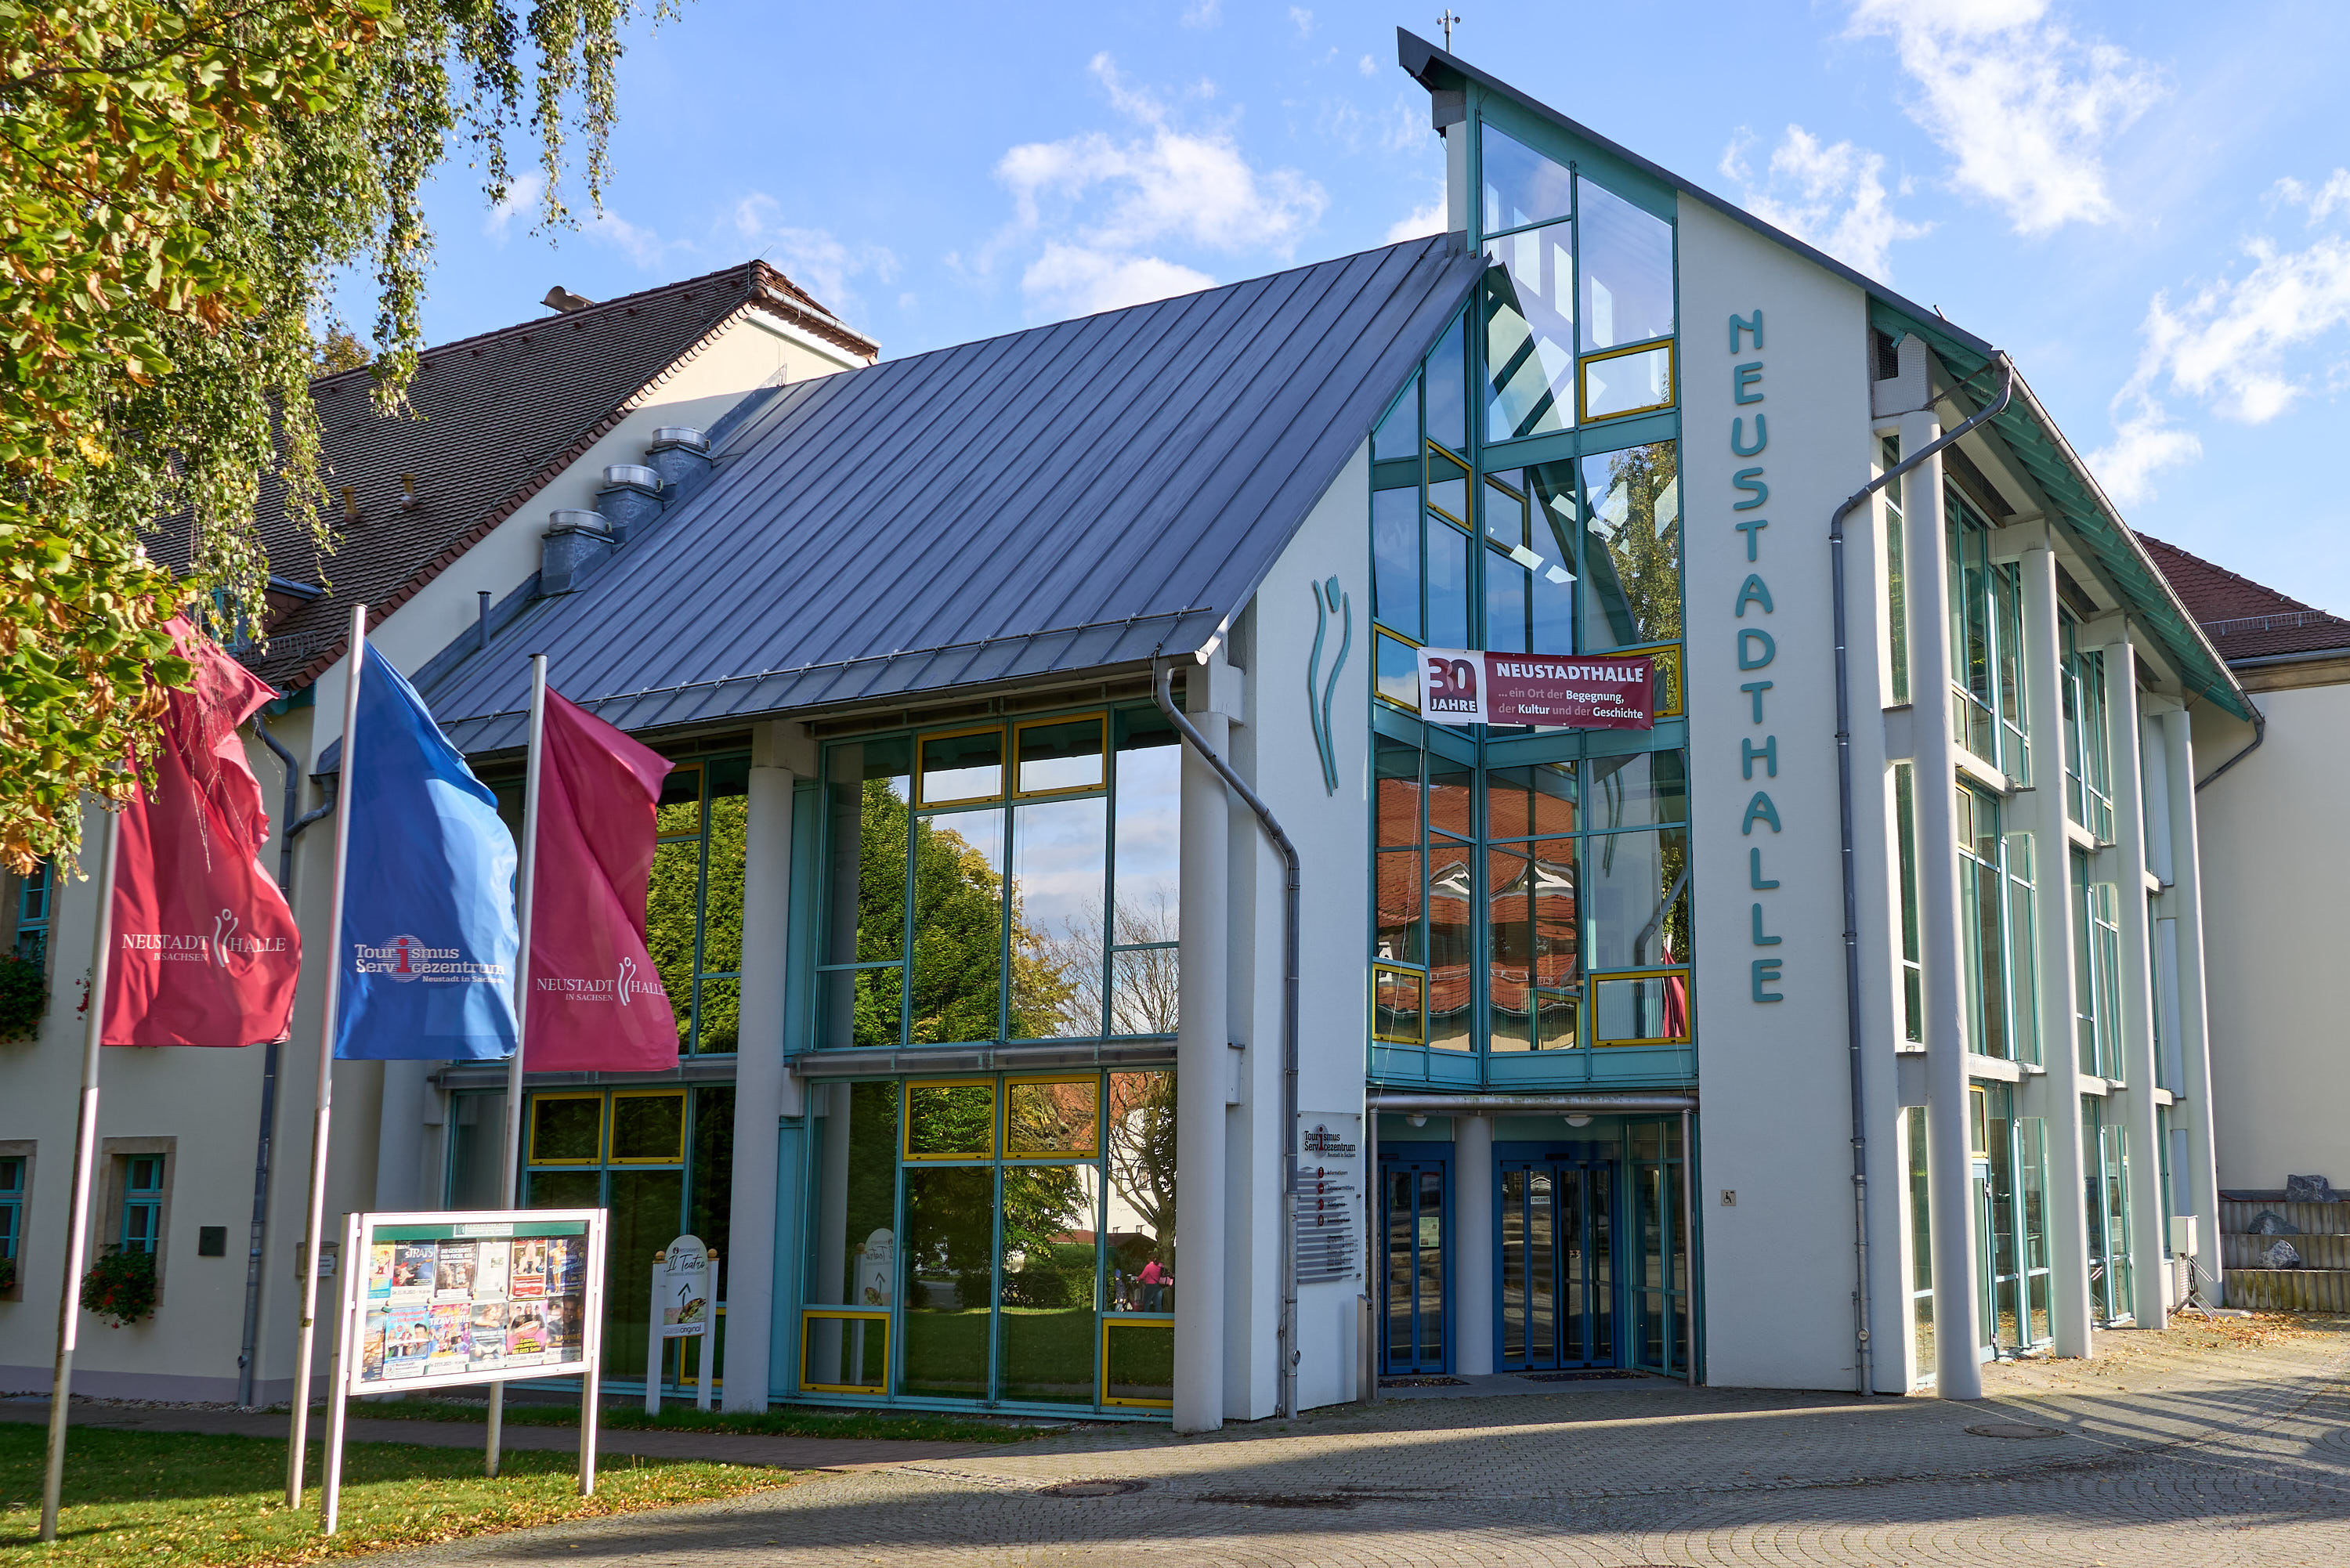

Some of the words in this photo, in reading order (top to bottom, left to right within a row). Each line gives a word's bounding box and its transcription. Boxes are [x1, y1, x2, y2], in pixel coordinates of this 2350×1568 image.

[1729, 309, 1784, 1003] NEUSTADTHALLE
[1427, 657, 1477, 699] 30
[1496, 663, 1643, 682] NEUSTADTHALLE
[1528, 688, 1545, 699] Ort
[1547, 689, 1564, 699] der
[1566, 690, 1625, 704] Begegnung,
[1431, 699, 1477, 712] JAHRE
[1499, 703, 1516, 714] der
[1518, 704, 1549, 715] Kultur
[1552, 706, 1571, 715] und
[1574, 706, 1591, 716] der
[1593, 707, 1643, 719] Geschichte
[121, 934, 209, 950] NEUSTADT
[230, 938, 286, 952] HALLE
[355, 938, 460, 959] Tourismus
[161, 953, 208, 962] SACHSEN
[356, 959, 505, 975] Servicezentrum
[537, 978, 614, 992] NEUSTADT
[577, 993, 613, 1002] SACHSEN
[1304, 1127, 1340, 1141] Tourismus
[1304, 1141, 1356, 1151] Servicezentrum
[680, 1254, 705, 1272] Teatro
